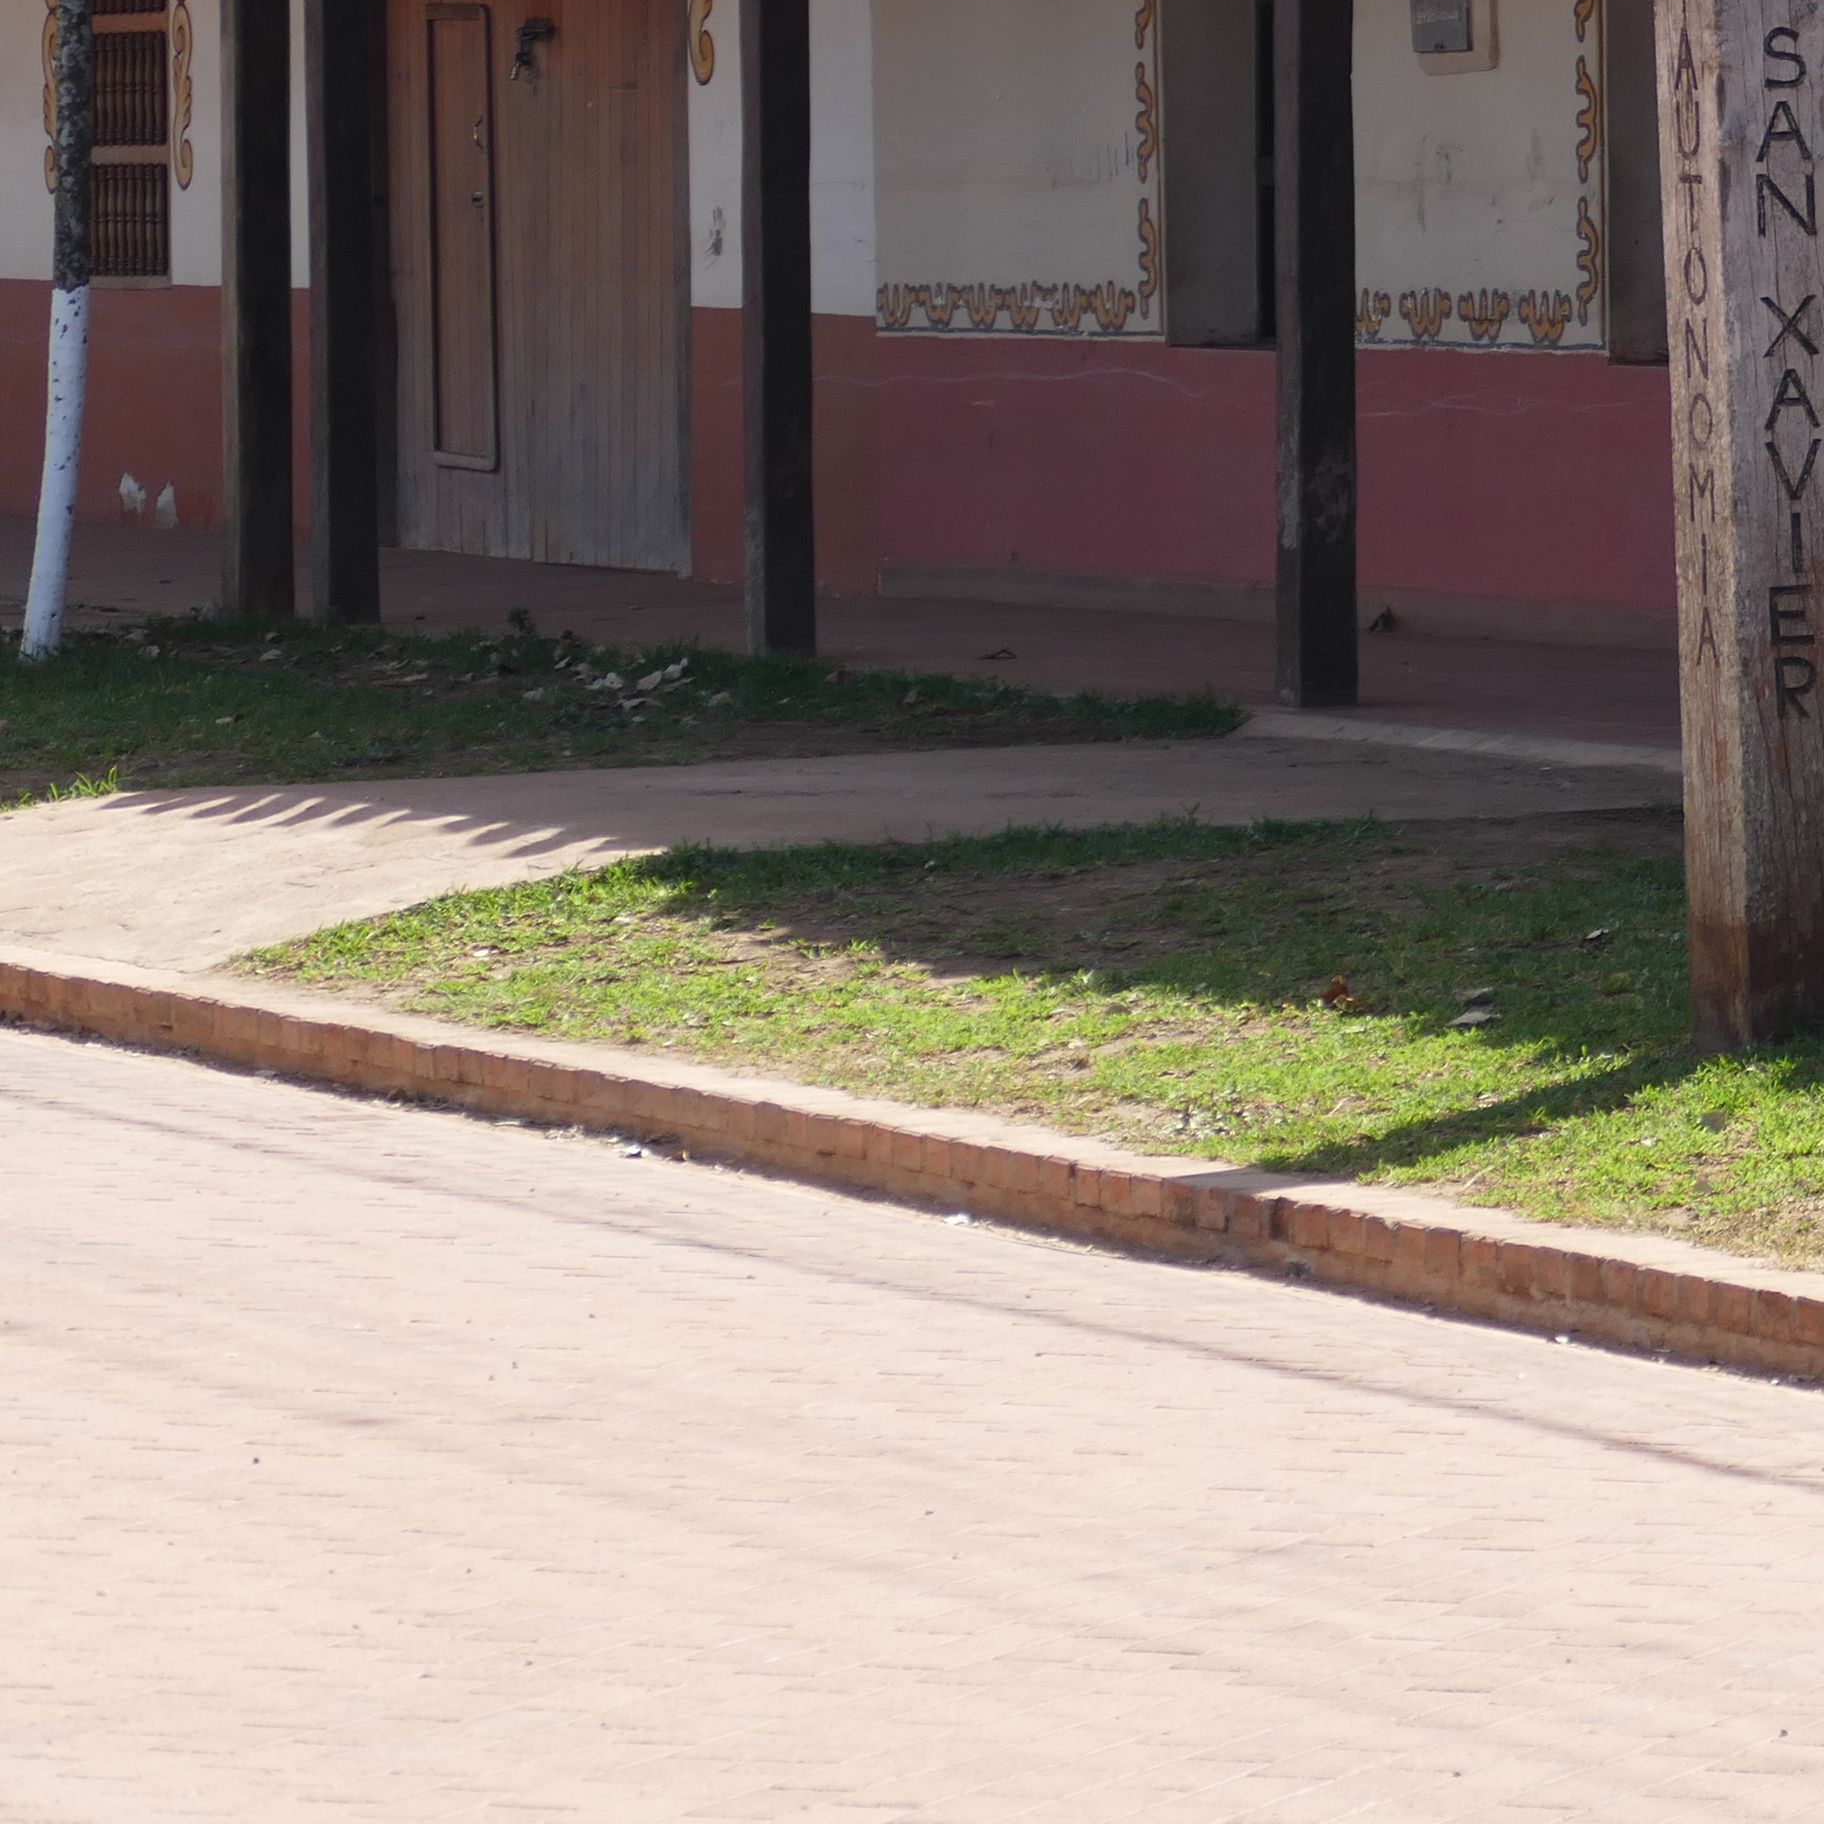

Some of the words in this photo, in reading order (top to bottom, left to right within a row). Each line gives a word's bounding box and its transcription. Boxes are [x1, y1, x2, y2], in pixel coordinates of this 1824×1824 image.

[1756, 26, 1818, 237] SAN
[1674, 26, 1720, 667] AUTONOMIA
[1759, 293, 1821, 721] XAVIER
